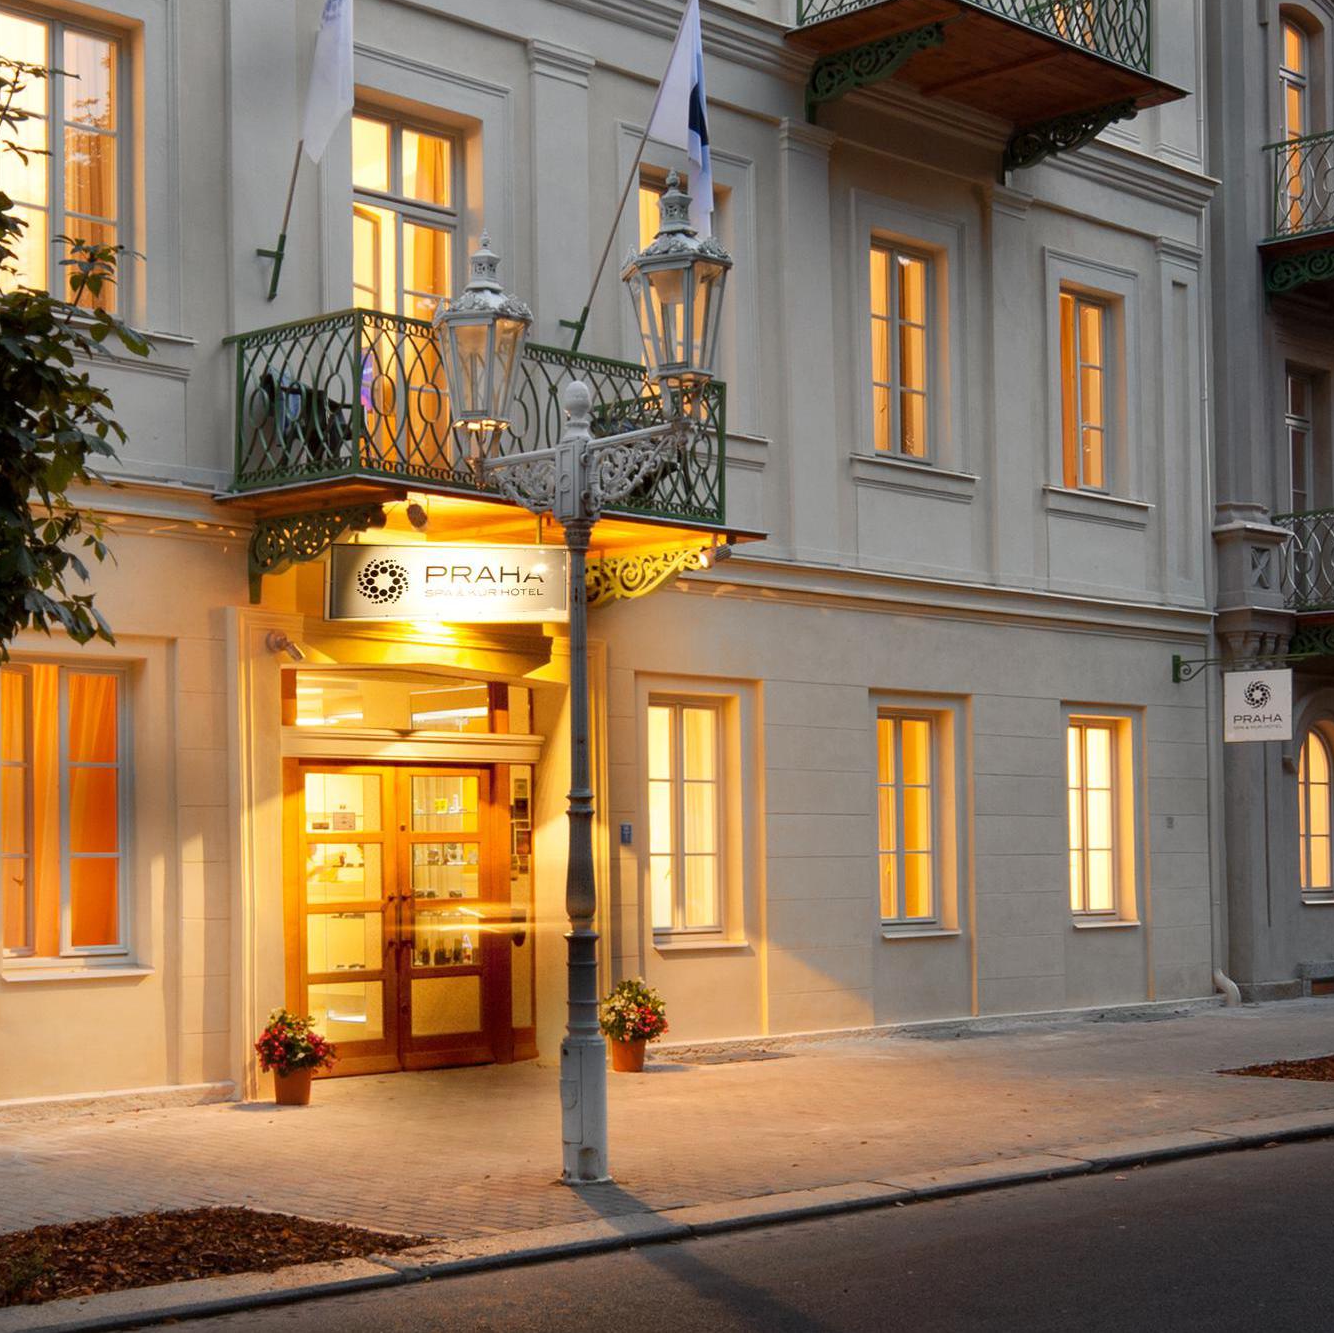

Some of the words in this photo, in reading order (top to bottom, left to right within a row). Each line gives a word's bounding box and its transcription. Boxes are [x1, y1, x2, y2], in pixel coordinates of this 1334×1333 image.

[425, 565, 545, 583] PRAHA
[425, 588, 453, 598] SPA
[467, 588, 497, 597] KUR
[500, 587, 544, 596] HOTEL
[1233, 713, 1283, 724] PRAHA
